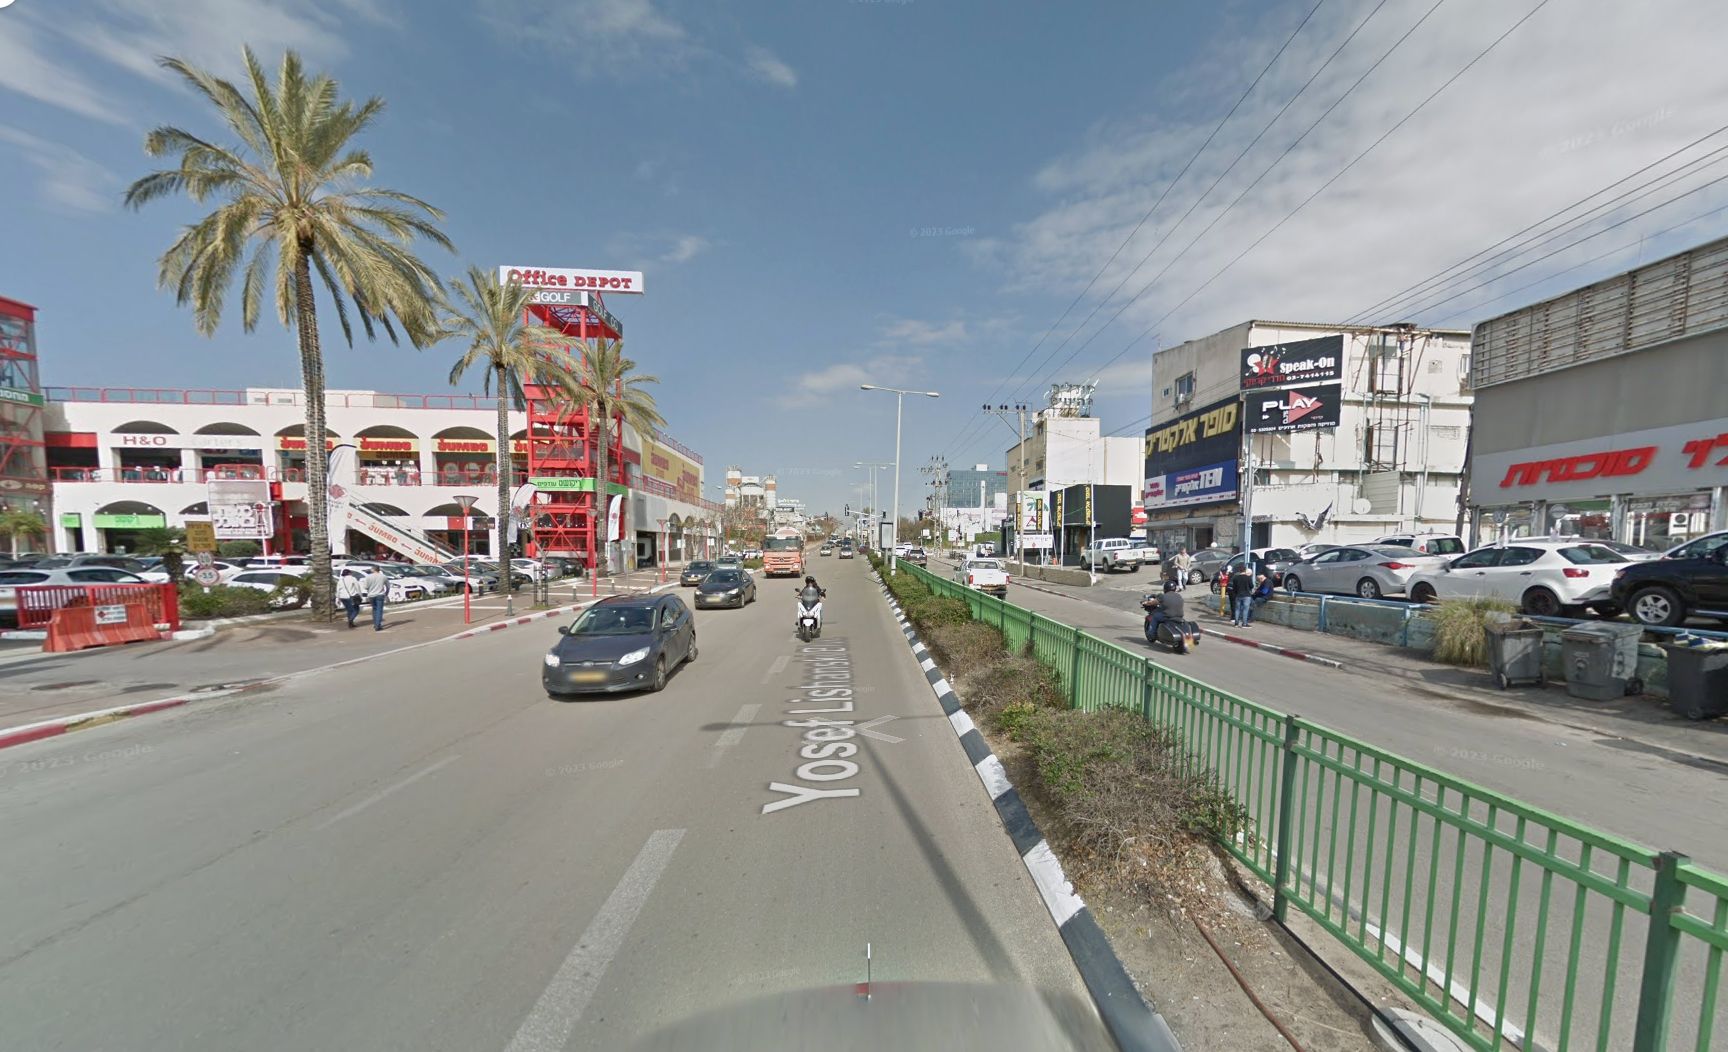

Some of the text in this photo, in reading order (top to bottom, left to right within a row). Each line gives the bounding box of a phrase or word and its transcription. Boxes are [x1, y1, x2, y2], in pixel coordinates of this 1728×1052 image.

[507, 269, 633, 289] Office DEPOT
[540, 291, 571, 303] GOLF
[593, 300, 608, 319] GOLF
[1280, 357, 1335, 374] Speak-On
[1262, 396, 1318, 412] PLAY
[1145, 402, 1238, 460] סופר אלקטריק
[122, 435, 167, 446] H&O
[360, 437, 412, 451] JUMBO
[438, 438, 489, 452] JUMBO
[651, 445, 669, 471] JUMBO
[1199, 467, 1223, 489] TEN
[368, 522, 398, 544] JUMBO
[414, 546, 444, 564] JUMB
